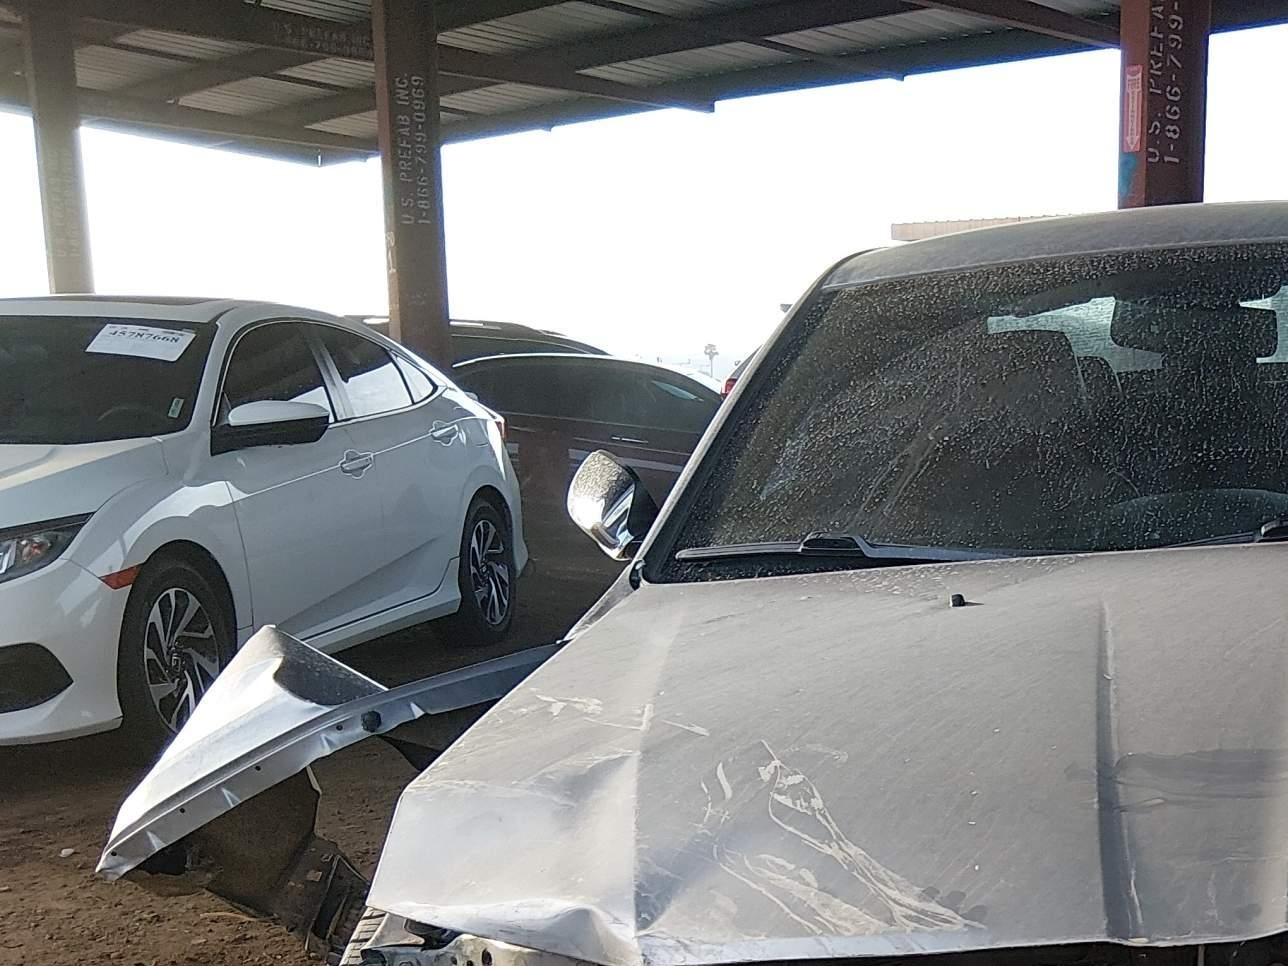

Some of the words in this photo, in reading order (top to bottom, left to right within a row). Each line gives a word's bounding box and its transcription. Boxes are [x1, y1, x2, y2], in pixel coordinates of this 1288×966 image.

[1149, 0, 1164, 94] PREFA
[395, 73, 409, 105] INC.
[397, 115, 414, 183] PREFAB
[411, 76, 432, 225] 1-866-799-0969
[1147, 112, 1162, 163] U.S.
[401, 193, 415, 225] US.
